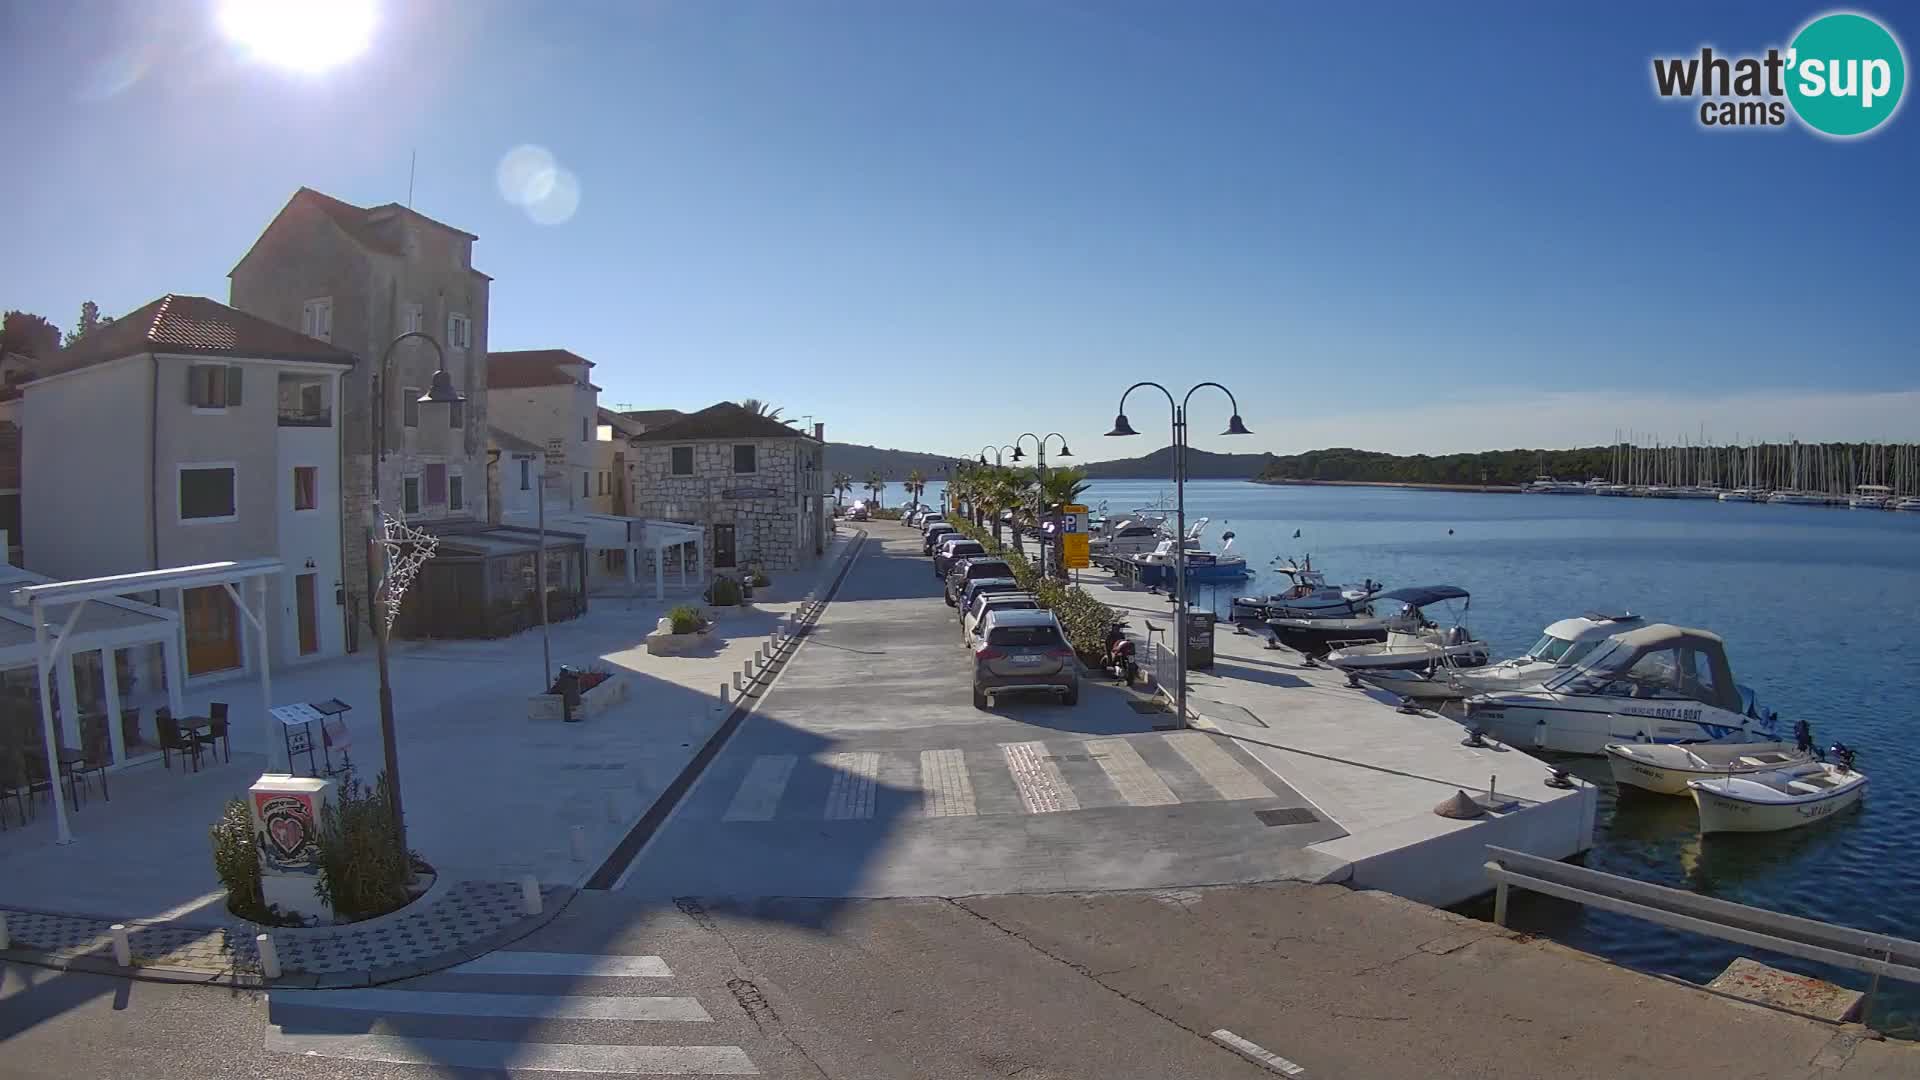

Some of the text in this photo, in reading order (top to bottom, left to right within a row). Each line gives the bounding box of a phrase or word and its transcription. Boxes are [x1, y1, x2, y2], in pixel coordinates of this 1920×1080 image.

[1066, 515, 1075, 531] P
[1656, 708, 1675, 719] RENT
[1683, 709, 1702, 720] BOAT
